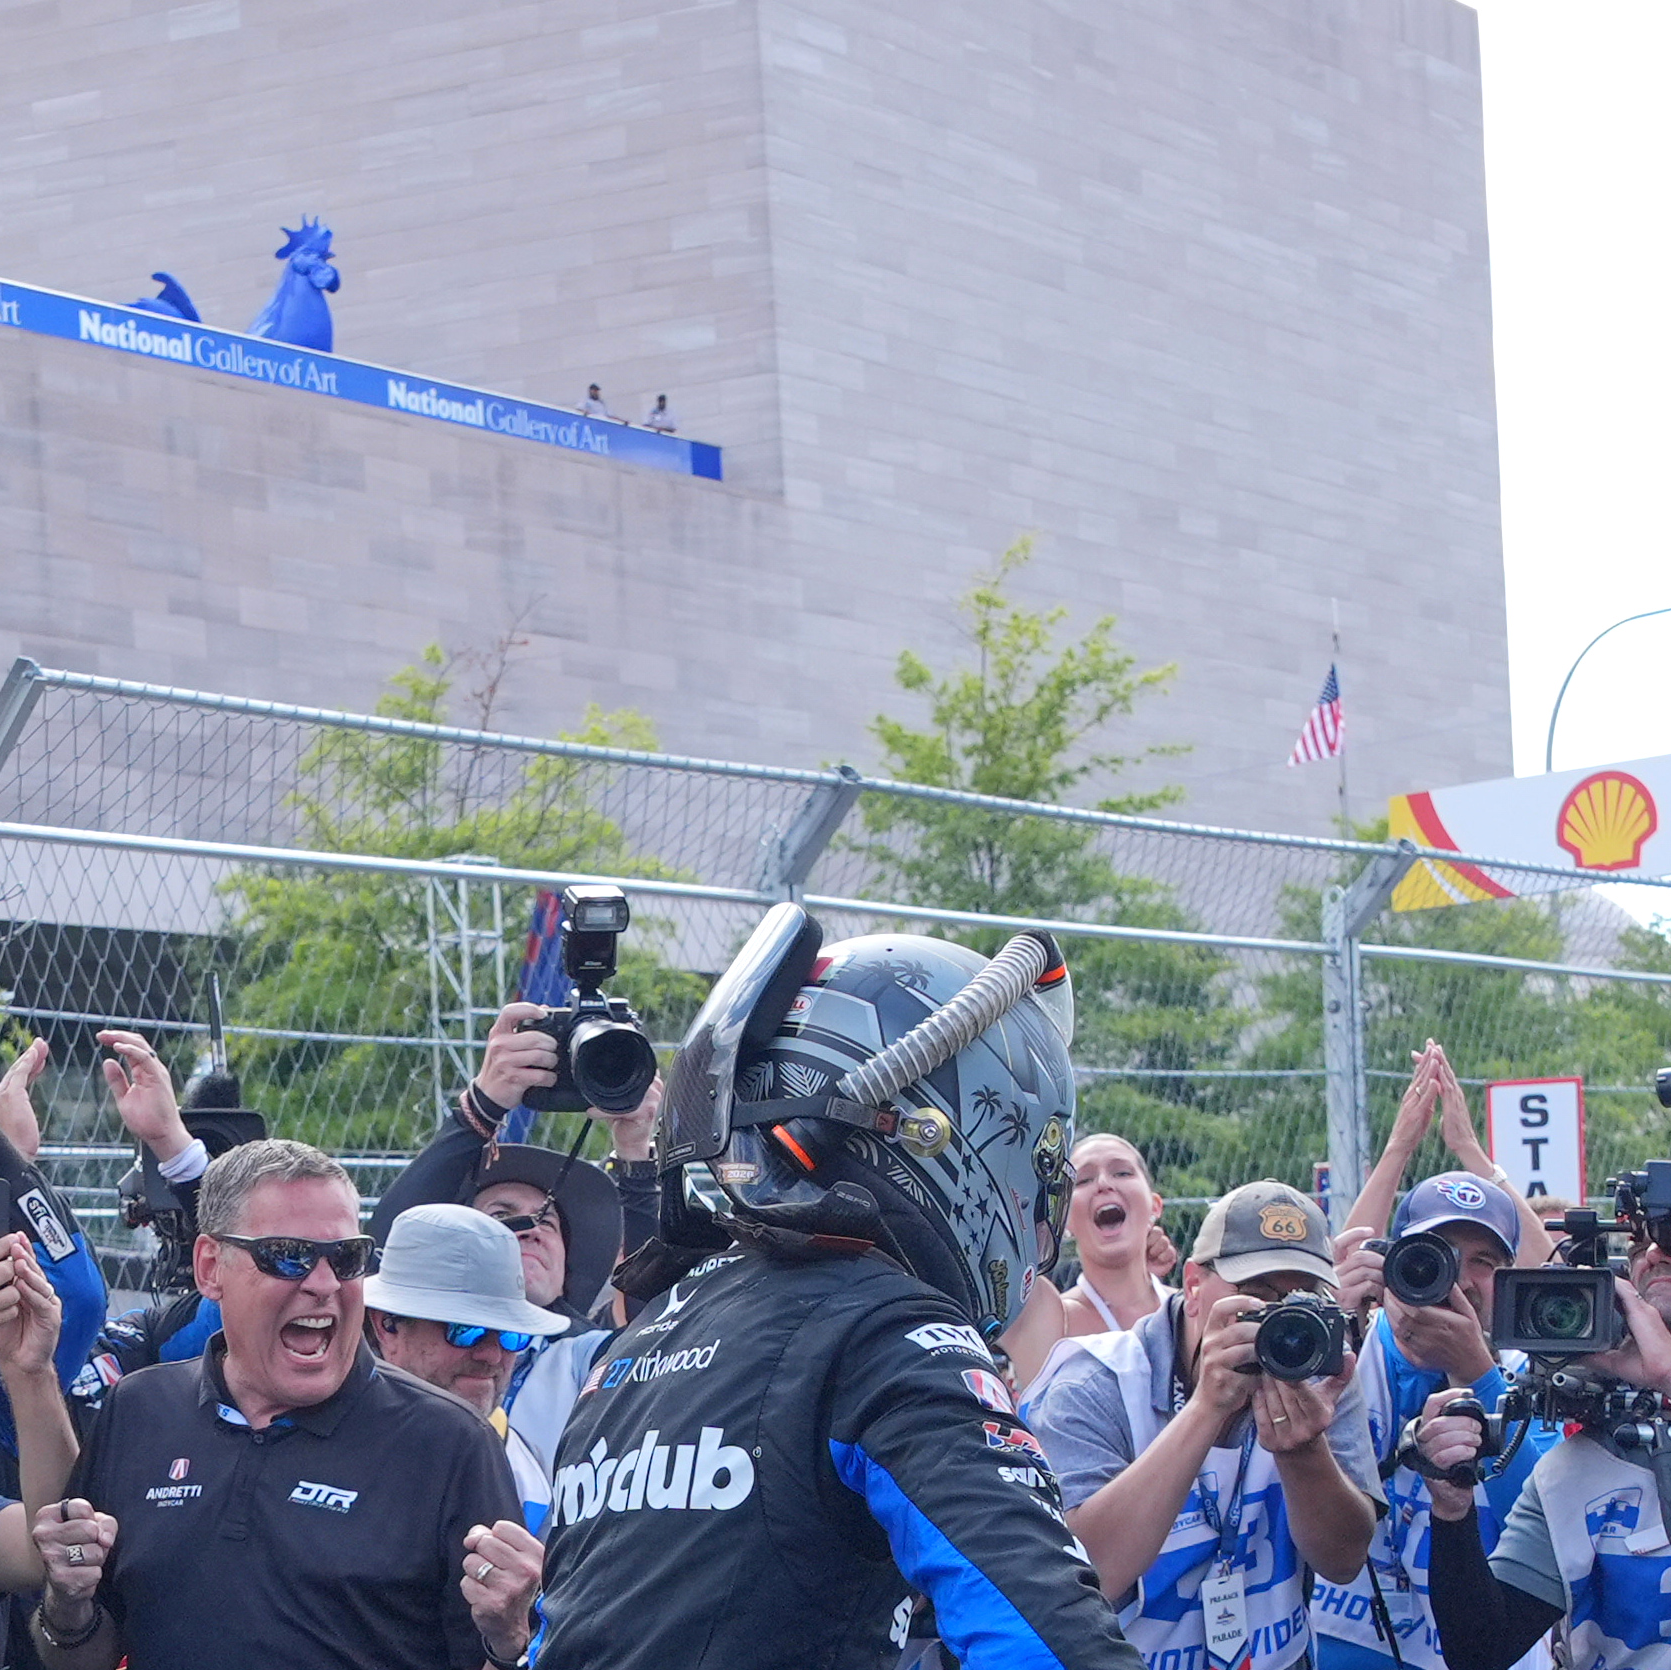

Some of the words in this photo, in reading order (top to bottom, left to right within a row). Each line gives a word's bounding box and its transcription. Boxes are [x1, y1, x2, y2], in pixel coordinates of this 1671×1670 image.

[78, 308, 193, 364] National
[194, 335, 279, 385] Gallery
[279, 358, 302, 387] of
[303, 361, 339, 396] Art
[387, 378, 485, 429] National
[485, 401, 559, 445] Gallery
[558, 419, 579, 448] of
[579, 423, 610, 455] Art
[1272, 1219, 1296, 1234] 66
[602, 1357, 632, 1389] 27
[625, 1339, 721, 1383] Kirkwood
[1172, 1374, 1184, 1413] ONY
[607, 1425, 756, 1512] club
[145, 1484, 203, 1500] ANDRETTI
[1211, 1629, 1241, 1645] PARADE
